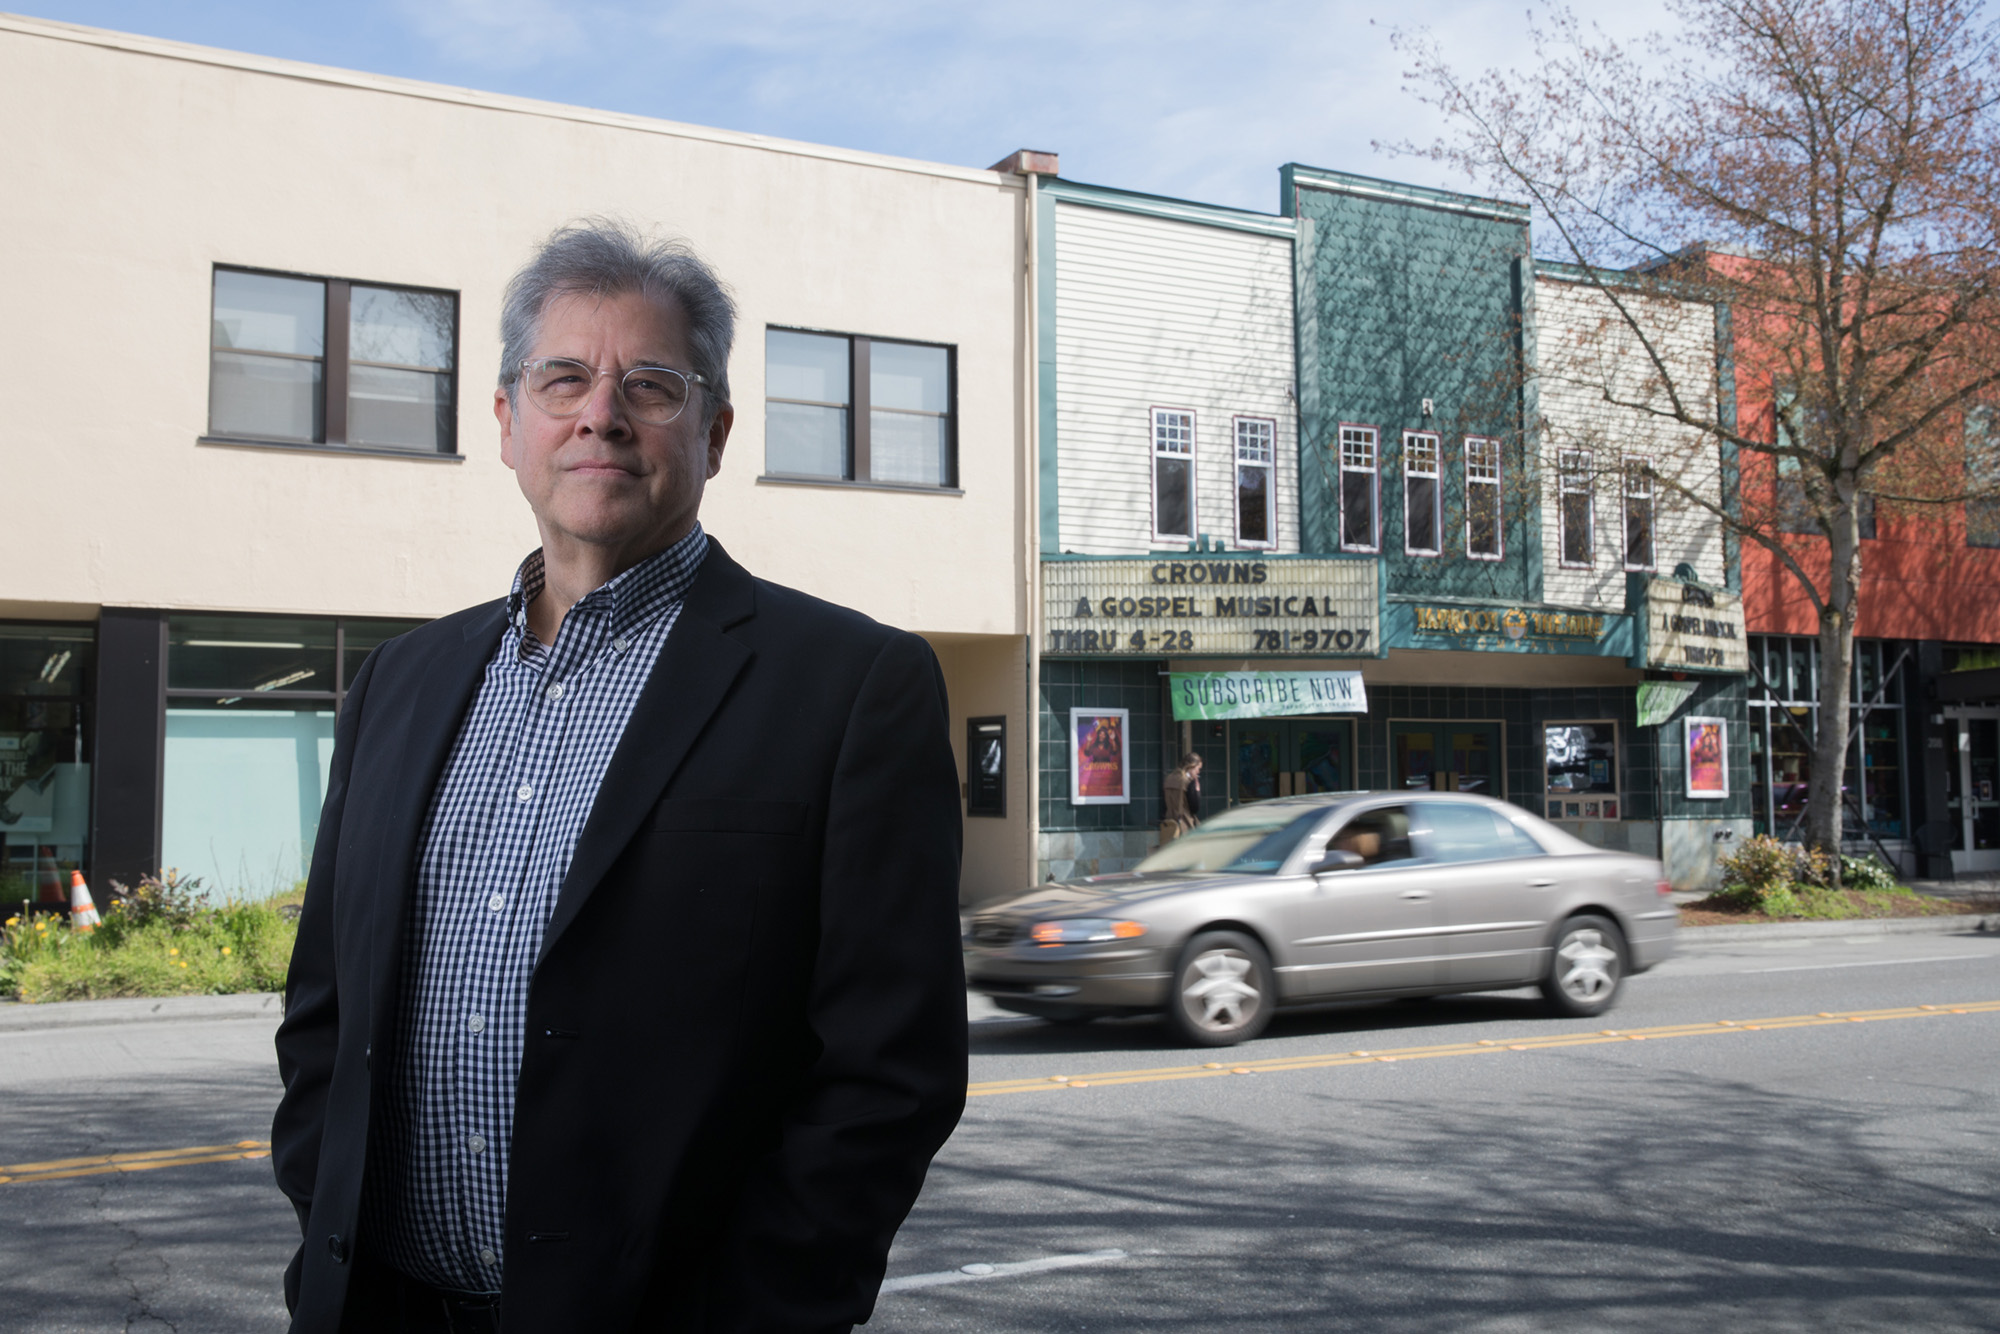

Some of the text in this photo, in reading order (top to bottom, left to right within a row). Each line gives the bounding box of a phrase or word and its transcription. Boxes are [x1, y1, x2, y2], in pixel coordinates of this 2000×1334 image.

[1151, 563, 1268, 585] CROWNS
[1075, 596, 1337, 618] A GOSPEL MUSICAL
[1414, 607, 1500, 634] TAPROOT
[1050, 629, 1371, 651] THRU 4-28 781-9707
[1459, 637, 1571, 652] COMPANY
[1183, 676, 1353, 707] SUBSCRIBE NOW
